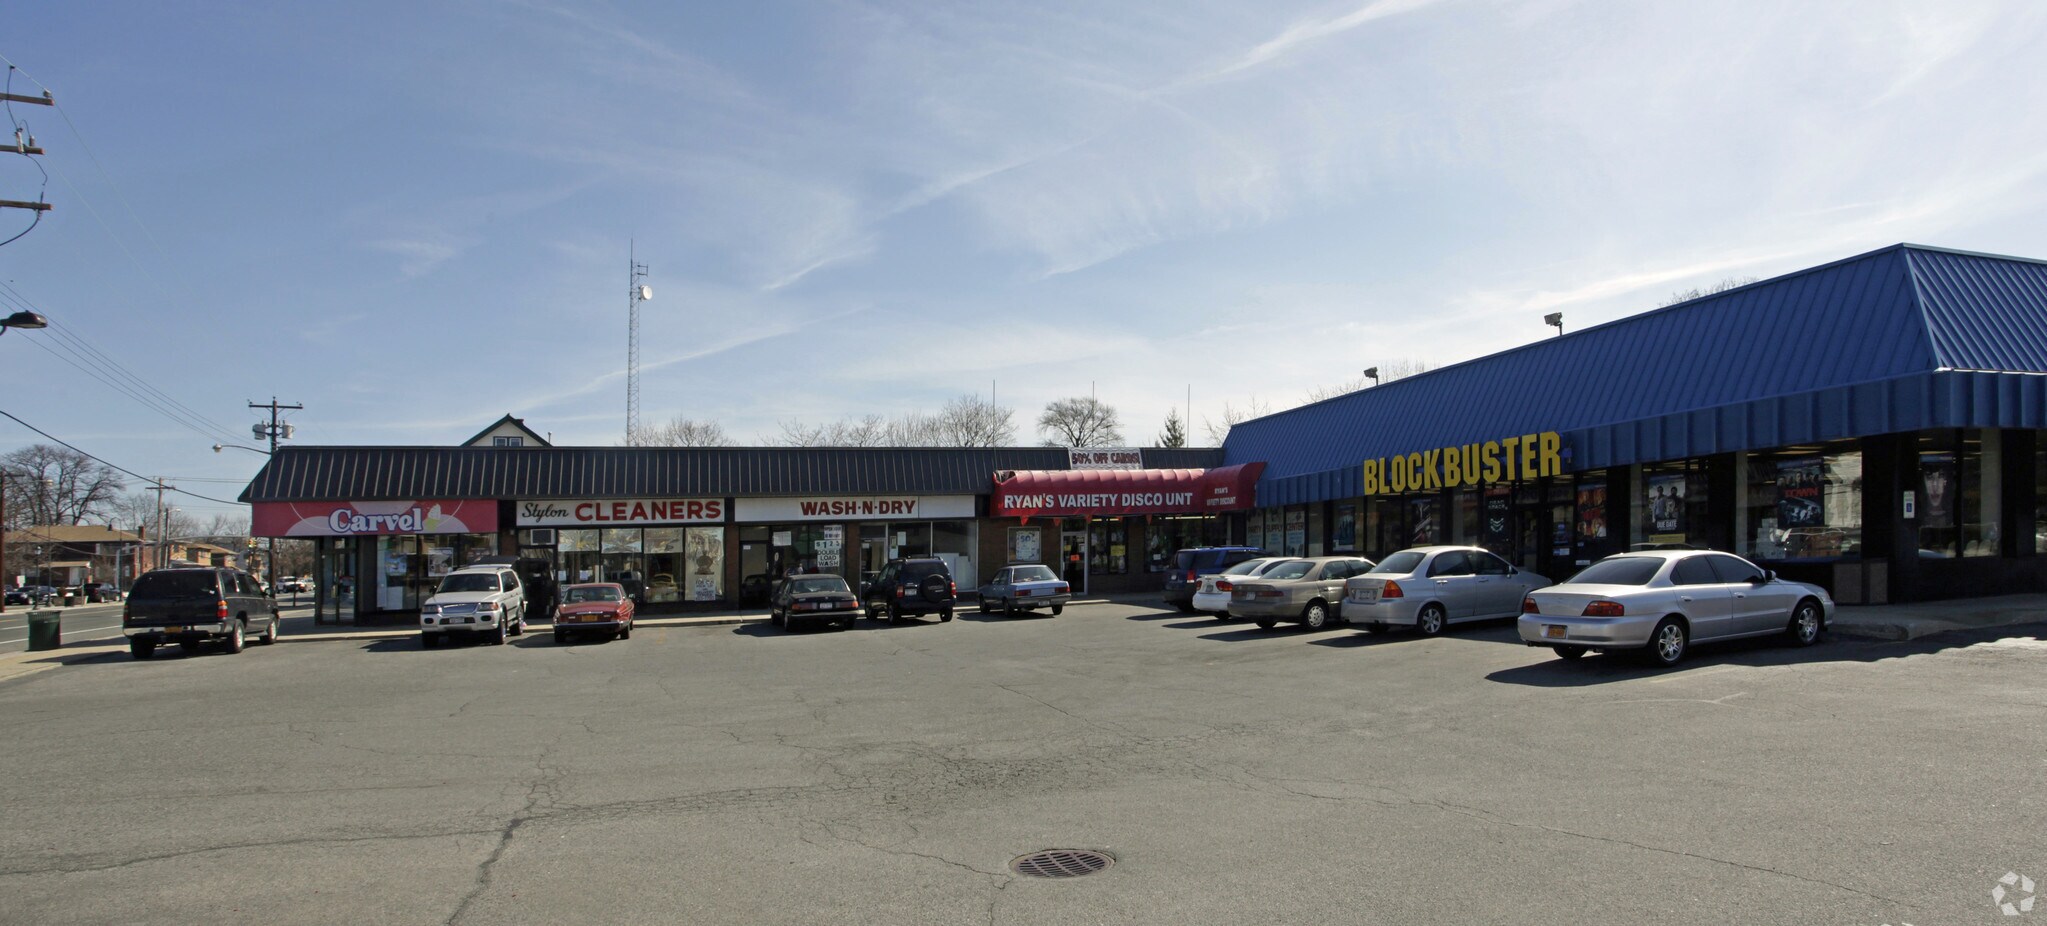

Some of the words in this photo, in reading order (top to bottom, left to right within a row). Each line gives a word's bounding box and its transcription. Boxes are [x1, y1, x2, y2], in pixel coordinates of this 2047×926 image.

[1072, 452, 1092, 464] 50%
[1093, 452, 1109, 464] OFF
[1363, 431, 1561, 495] BLOCKBUSTER
[1004, 493, 1055, 509] RYAN'S
[1057, 493, 1119, 508] VARIETY
[1121, 493, 1163, 507] DISCO
[1166, 492, 1193, 506] UNT
[328, 507, 423, 533] Carvel
[522, 503, 570, 523] Stylon
[574, 501, 722, 522] CLEANERS
